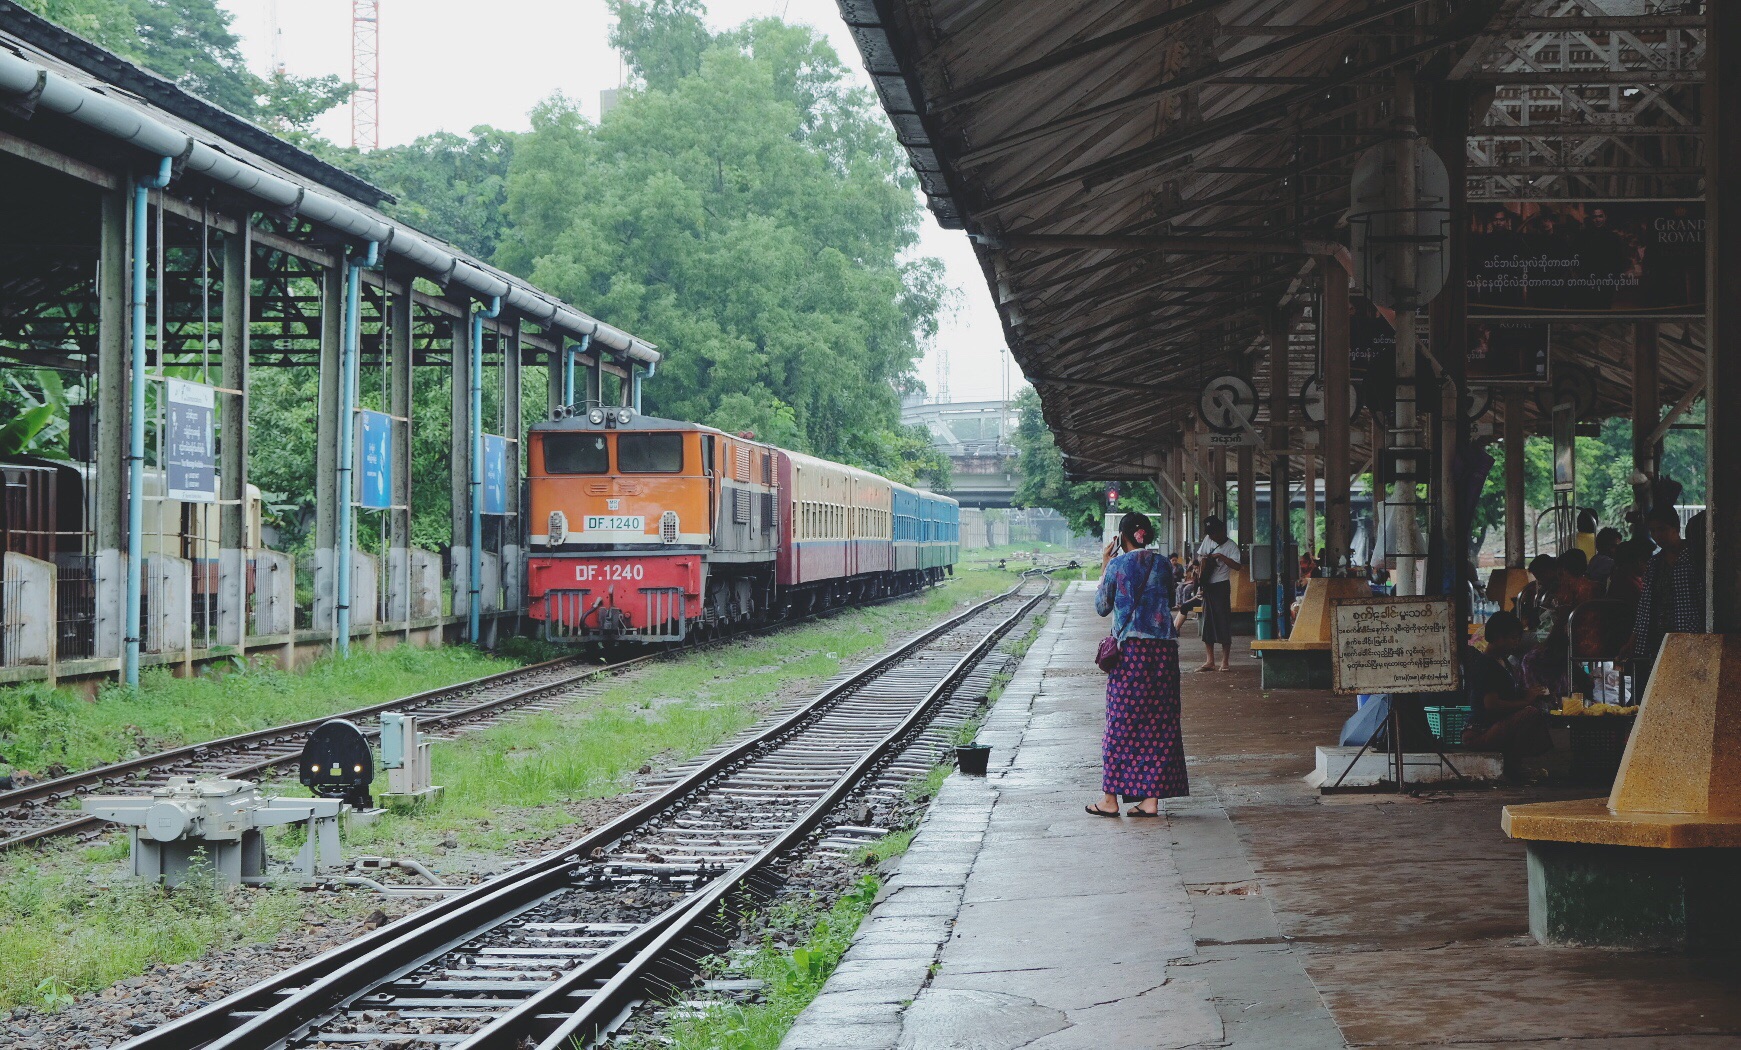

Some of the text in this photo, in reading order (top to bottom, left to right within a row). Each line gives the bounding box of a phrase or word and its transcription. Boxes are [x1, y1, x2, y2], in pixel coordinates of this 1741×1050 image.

[1654, 217, 1705, 231] GRAND
[1658, 231, 1705, 243] ROYAL
[1484, 254, 1580, 273] သင်ဘယ်သူလဲဆိုတာထက်
[588, 517, 640, 529] DF.1240
[575, 564, 644, 581] DF.1240
